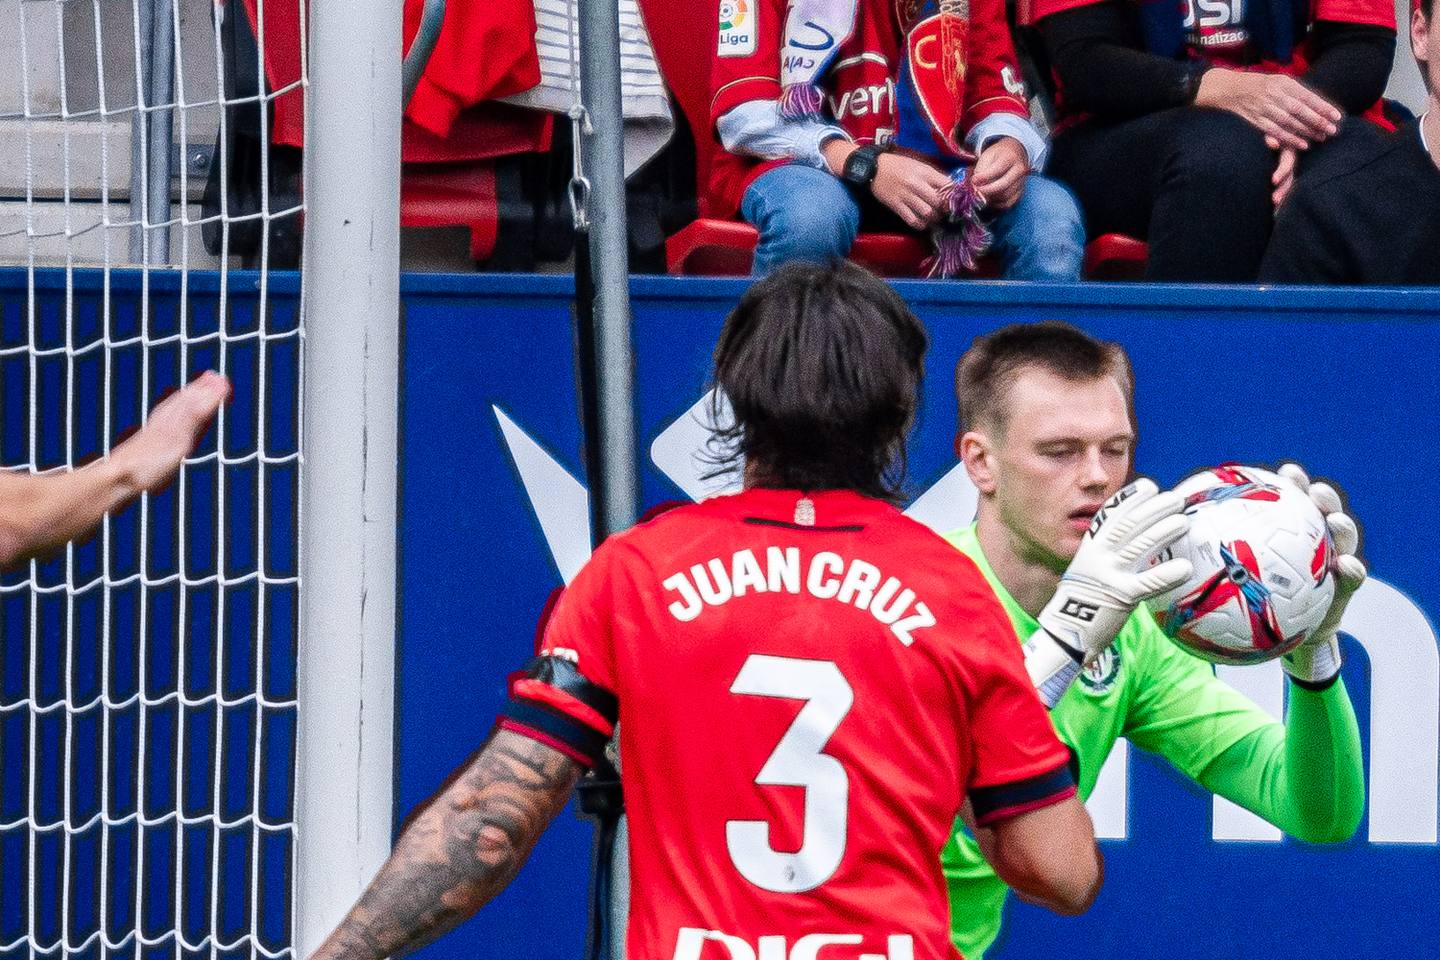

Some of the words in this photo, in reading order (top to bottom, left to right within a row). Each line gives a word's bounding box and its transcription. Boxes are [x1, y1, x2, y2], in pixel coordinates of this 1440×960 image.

[662, 547, 800, 623] JUAN
[807, 551, 936, 647] CRUZ
[725, 653, 855, 894] 3
